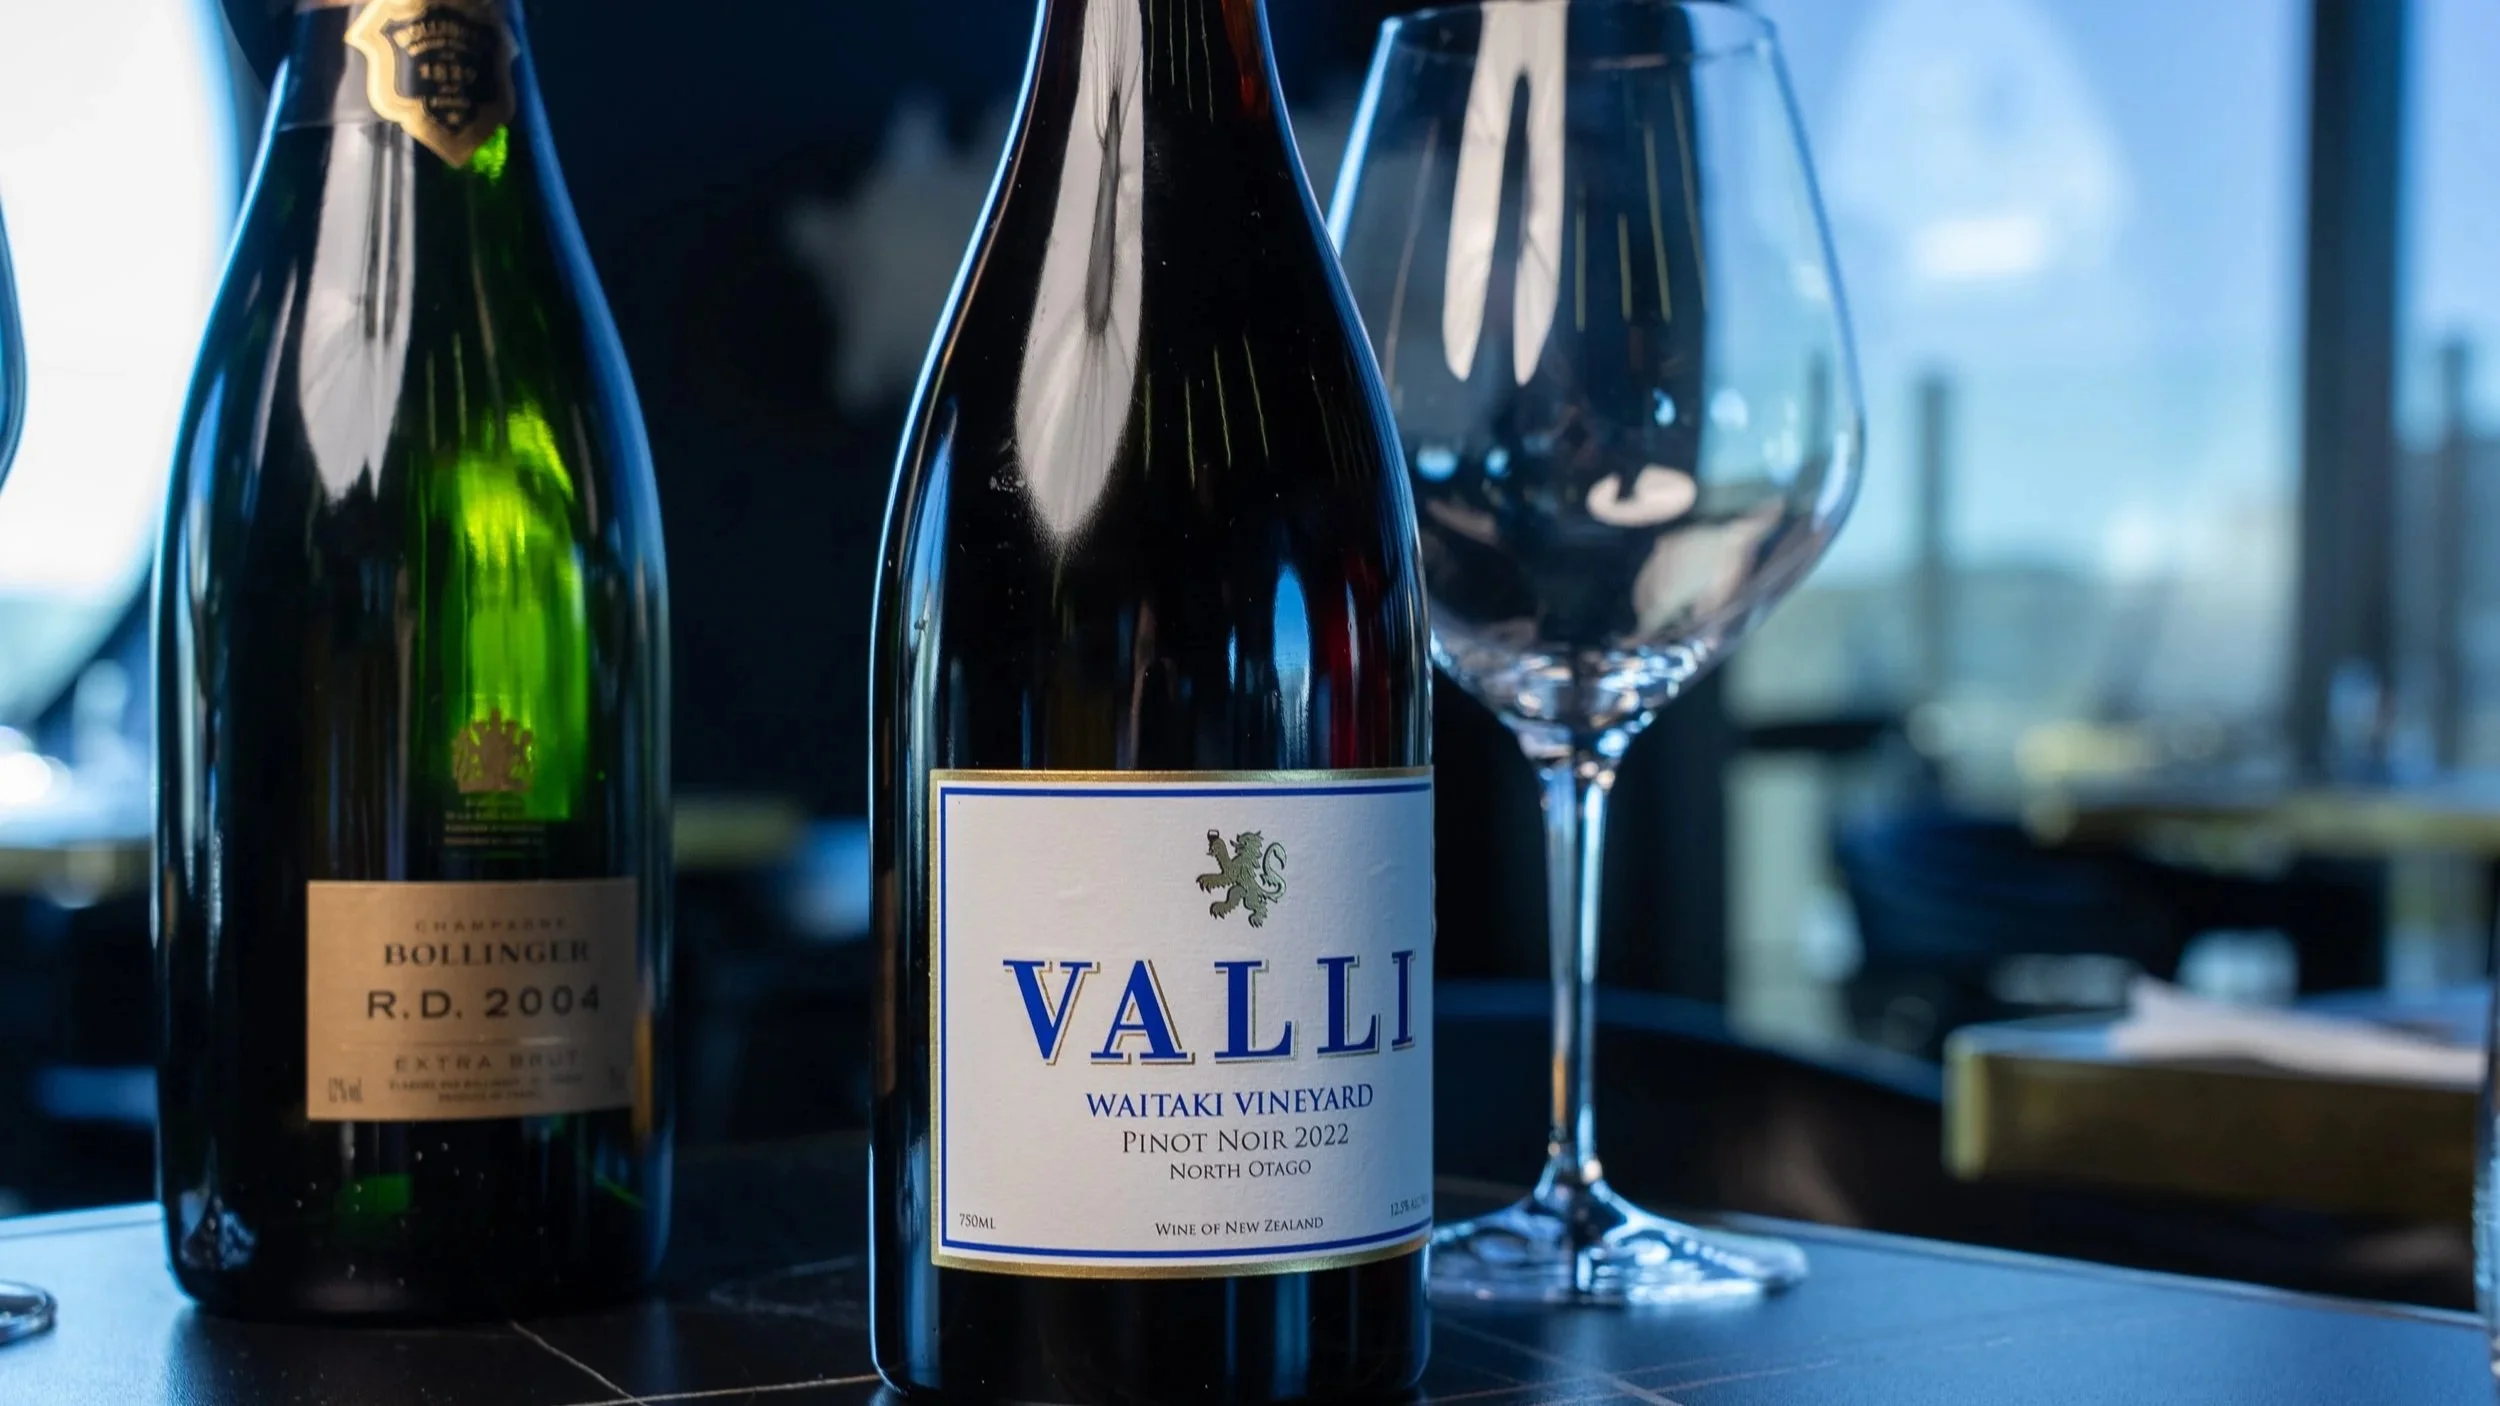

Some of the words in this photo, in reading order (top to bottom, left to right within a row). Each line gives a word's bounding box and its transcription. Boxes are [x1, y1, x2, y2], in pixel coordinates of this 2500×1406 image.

[384, 940, 590, 967] BOLLINGER
[367, 989, 463, 1020] R.D.
[484, 983, 600, 1018] 2004
[1002, 948, 1416, 1067] VALLI
[395, 1055, 492, 1073] EXTRA
[509, 1049, 579, 1069] BRUT
[1086, 1092, 1224, 1118] WAITAKI
[1233, 1083, 1374, 1116] VINEYARD
[1122, 1130, 1208, 1154] PINOT
[1218, 1128, 1288, 1152] NOIR
[1295, 1123, 1350, 1149] 2022
[1170, 1163, 1241, 1180] NORTH
[1248, 1159, 1312, 1178] OTAGO
[1155, 1222, 1197, 1237] WINE
[1200, 1222, 1221, 1235] OF
[1225, 1220, 1260, 1235] NEW
[1264, 1216, 1324, 1233] ZEALAND
